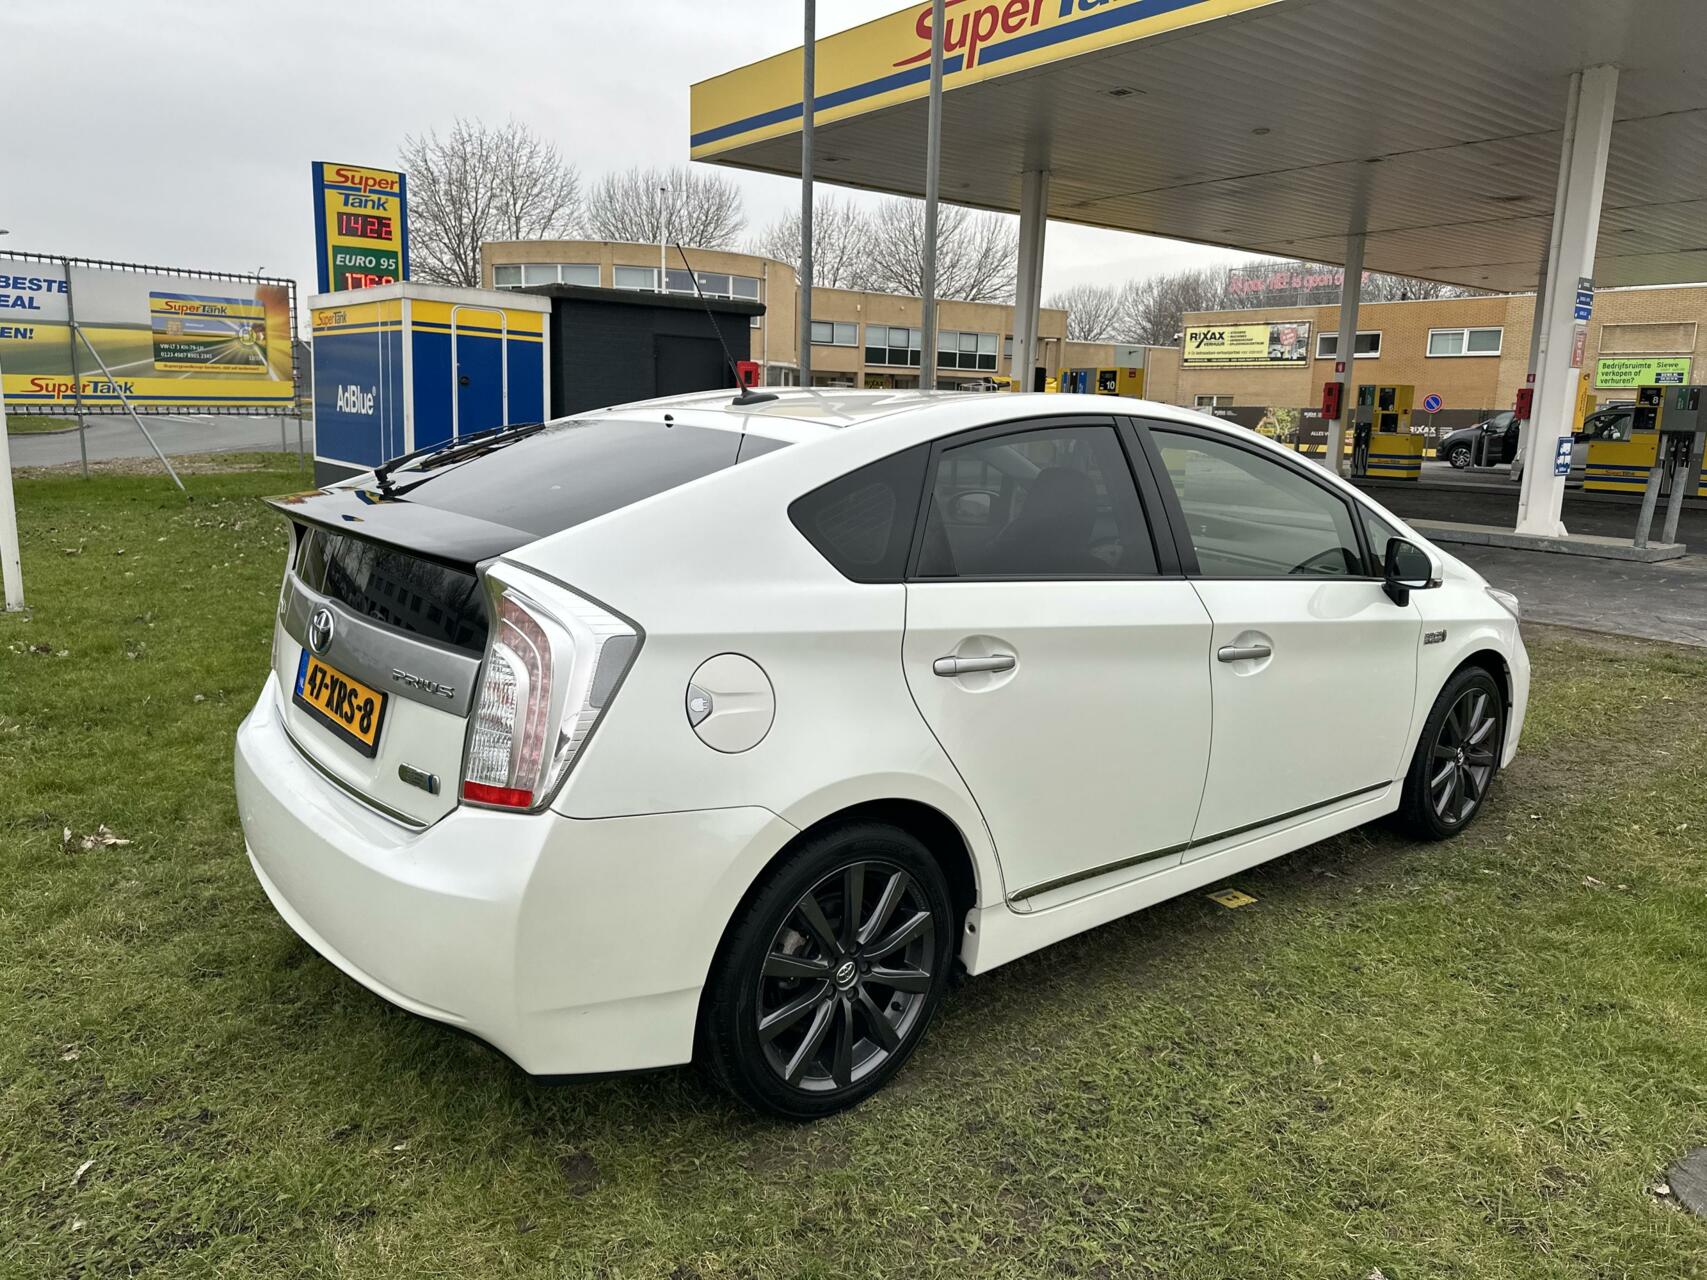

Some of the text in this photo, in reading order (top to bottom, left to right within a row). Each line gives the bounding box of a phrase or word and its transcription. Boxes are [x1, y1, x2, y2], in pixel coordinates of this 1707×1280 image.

[325, 168, 398, 193] Super
[337, 192, 389, 211] Tank
[336, 254, 397, 269] EURO 95
[1190, 331, 1225, 349] RIXAX
[1106, 381, 1116, 390] 10
[1652, 396, 1659, 404] 8
[392, 668, 456, 699] PRIUS
[308, 663, 376, 735] 47-XRS-8
